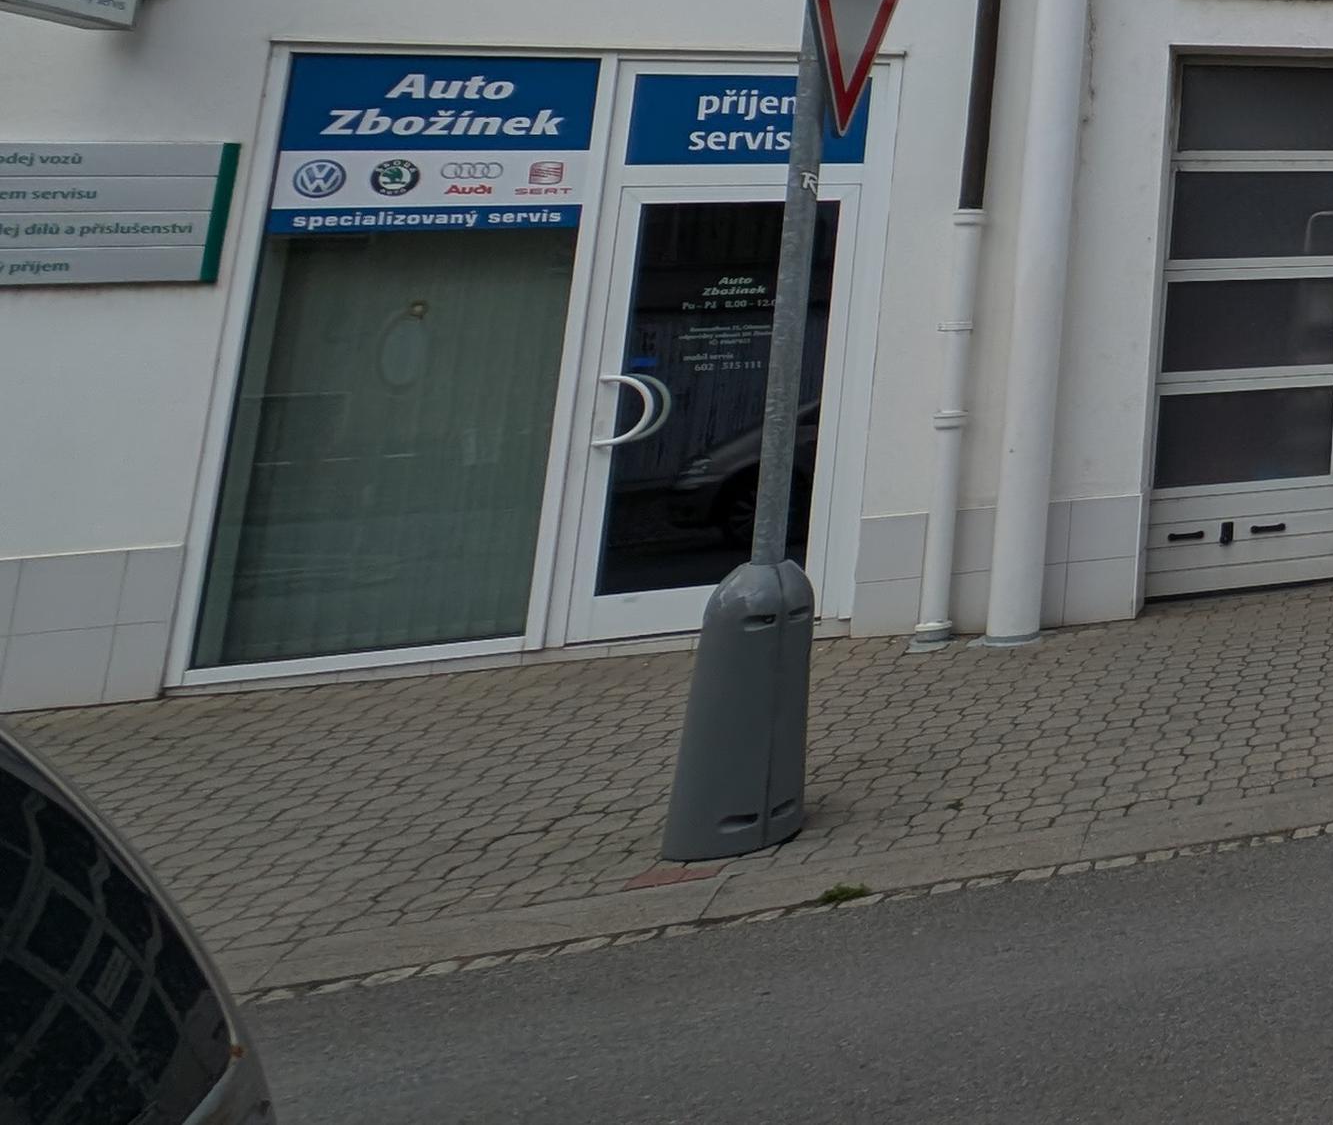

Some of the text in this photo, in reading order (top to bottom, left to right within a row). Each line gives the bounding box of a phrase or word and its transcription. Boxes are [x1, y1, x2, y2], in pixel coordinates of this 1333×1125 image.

[384, 72, 515, 101] Auto
[318, 108, 565, 137] Zbožínek
[688, 125, 793, 151] servis
[40, 152, 83, 165] vozů
[32, 188, 97, 201] servisu
[443, 184, 493, 195] Audi
[292, 209, 561, 229] specializovaný servis
[64, 226, 73, 235] a
[80, 222, 193, 238] příslušenství
[9, 259, 70, 275] příjem
[719, 277, 753, 285] Auto
